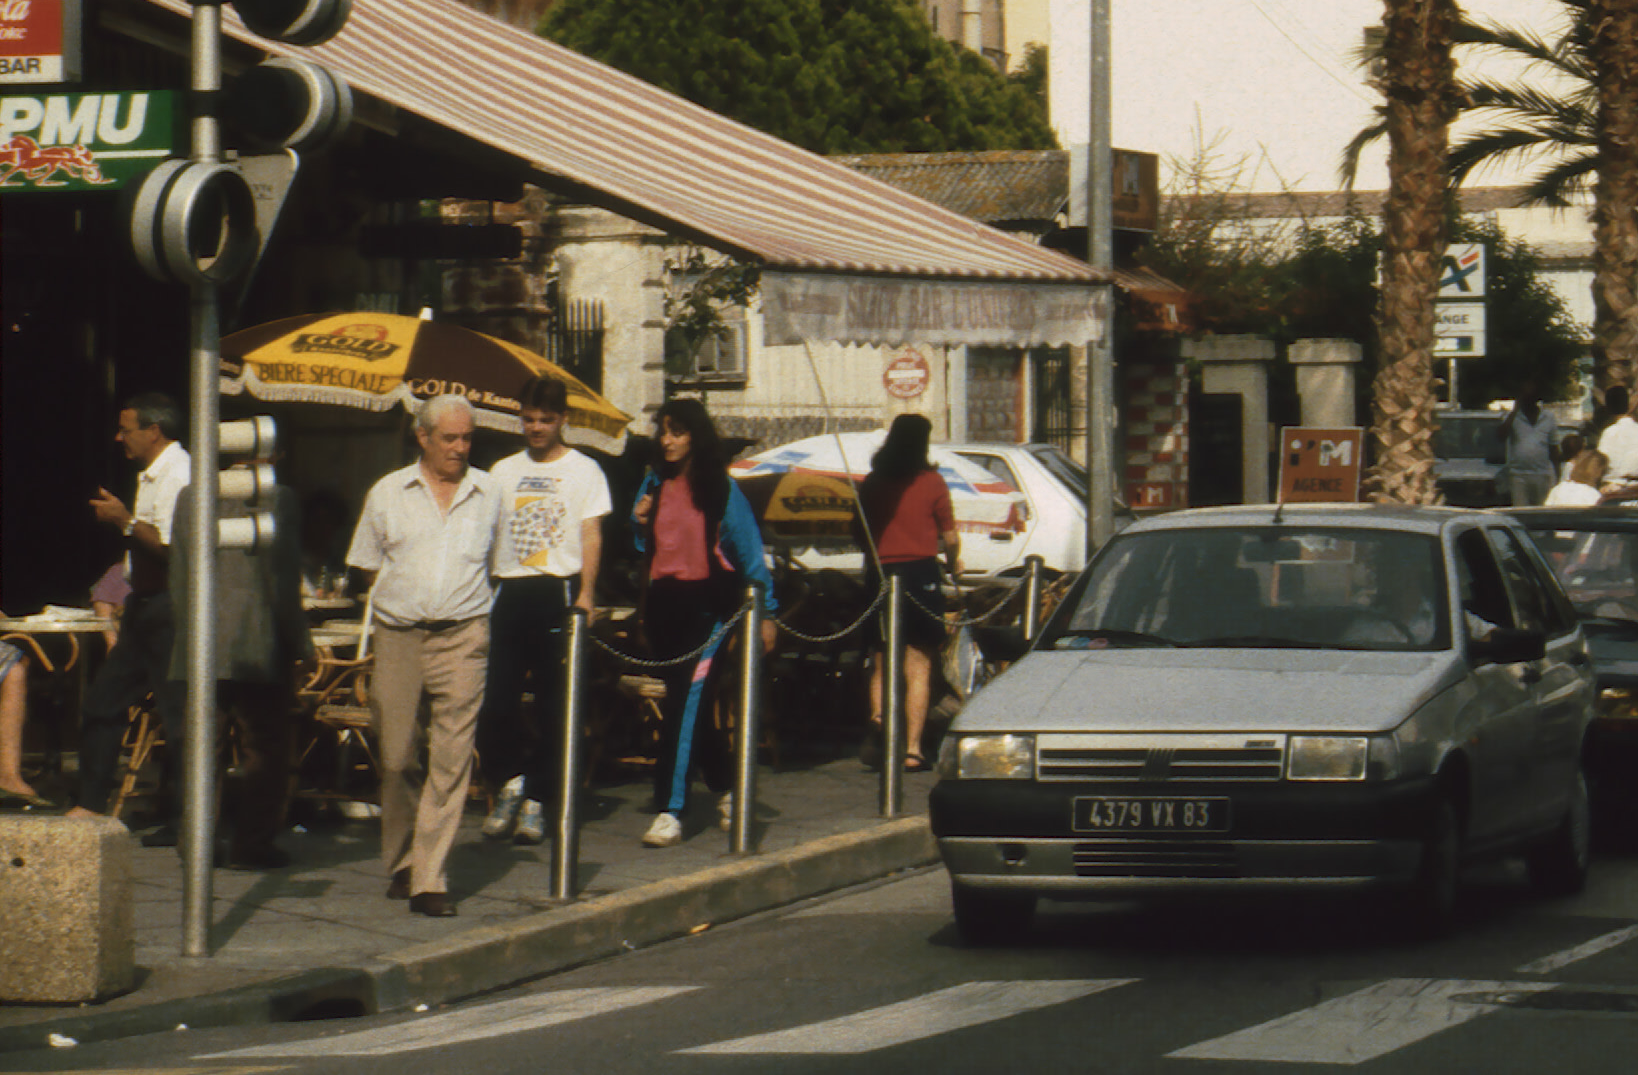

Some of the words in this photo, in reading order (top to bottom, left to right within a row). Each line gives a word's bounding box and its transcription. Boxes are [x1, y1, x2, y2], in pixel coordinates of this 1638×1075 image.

[0, 58, 41, 74] BAR
[0, 93, 149, 145] PMU
[1434, 313, 1470, 325] ANGE
[306, 335, 391, 352] GOLD
[408, 378, 467, 397] GOLD
[1292, 477, 1343, 493] AGENCE
[1090, 801, 1142, 827] 4379
[1152, 801, 1175, 827] VX
[1183, 801, 1210, 827] 83
